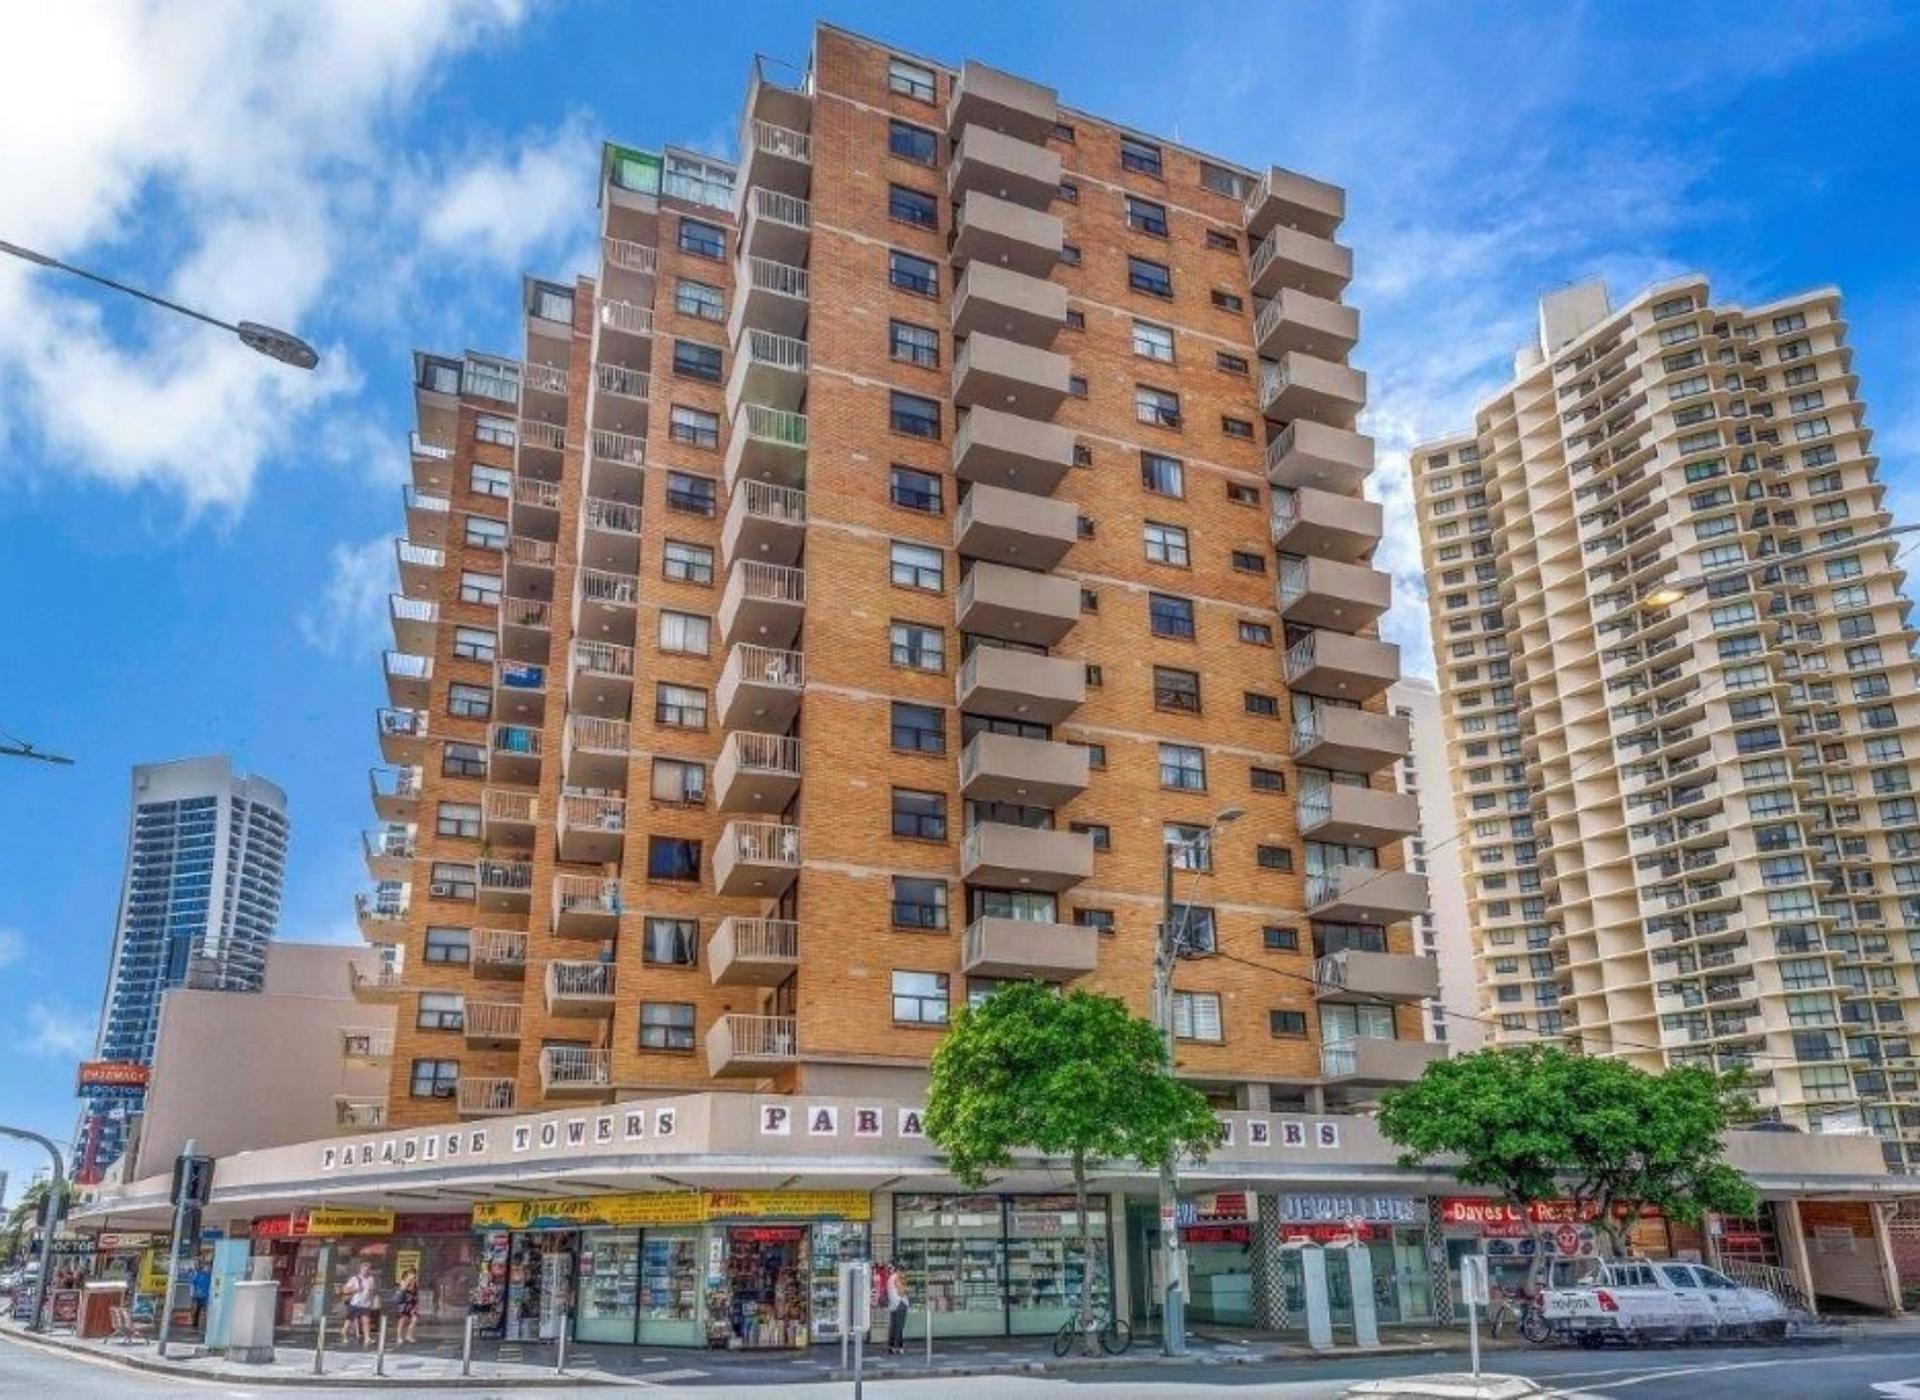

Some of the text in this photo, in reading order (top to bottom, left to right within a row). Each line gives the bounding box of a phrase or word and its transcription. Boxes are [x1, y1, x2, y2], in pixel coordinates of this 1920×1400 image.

[82, 1070, 146, 1082] PHARMACY
[324, 1112, 674, 1167] PARADISE TOWERS
[765, 1107, 1336, 1145] PARA WERS
[1453, 1202, 1503, 1221] Daves
